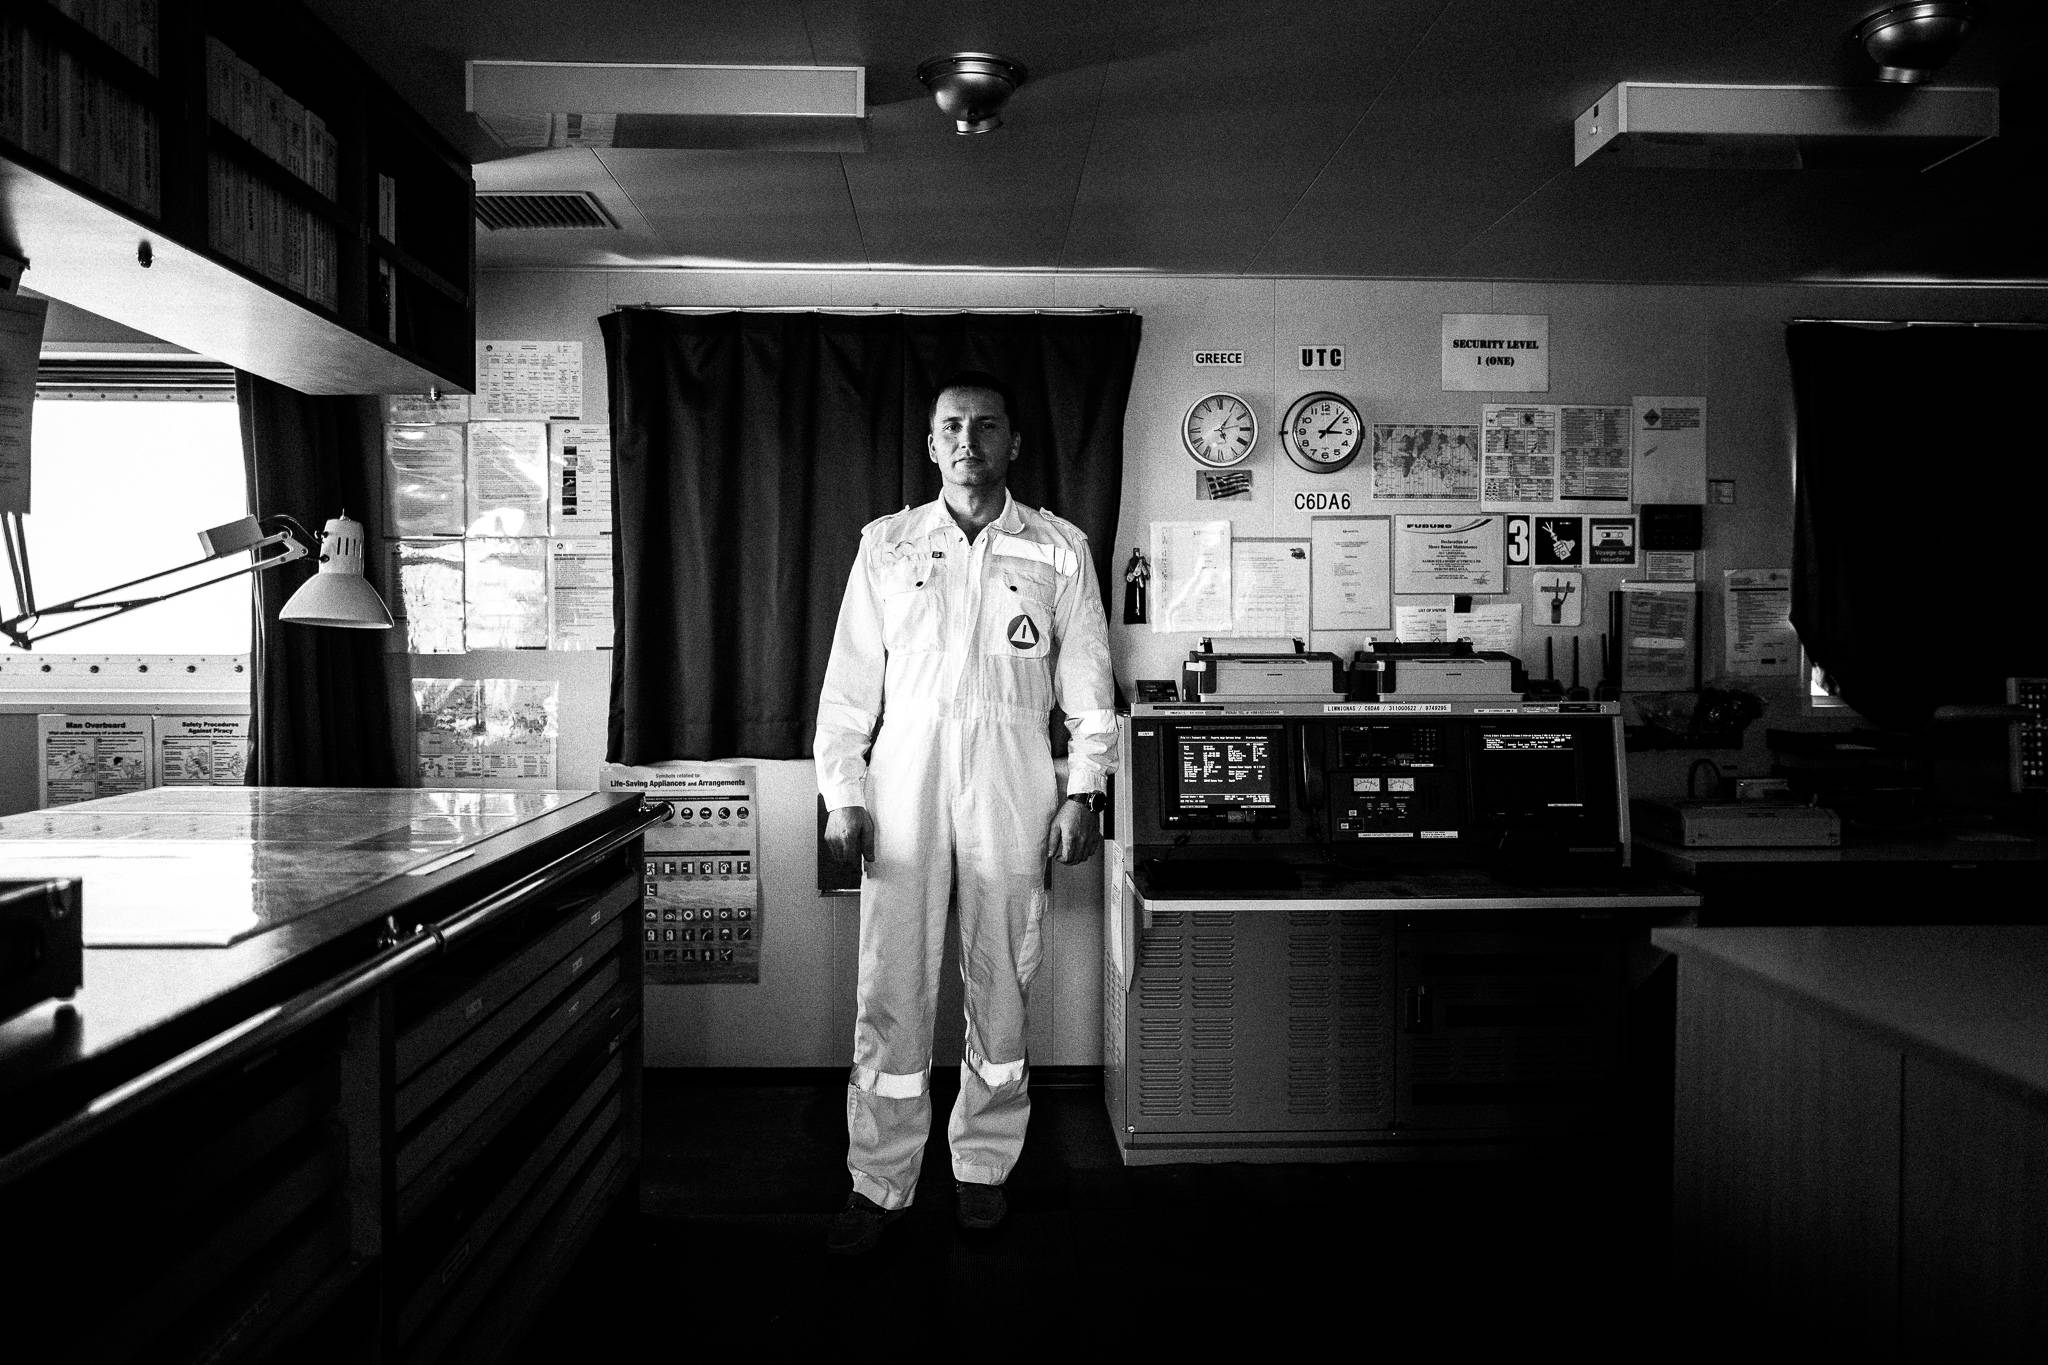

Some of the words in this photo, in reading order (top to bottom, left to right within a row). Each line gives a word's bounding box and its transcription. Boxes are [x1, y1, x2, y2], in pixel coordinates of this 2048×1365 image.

[1453, 340, 1504, 349] SECURITY
[1507, 341, 1539, 349] LEVEL
[1196, 353, 1242, 364] GREECE
[1302, 348, 1341, 367] UTC
[1486, 356, 1514, 367] (ONE)
[1311, 407, 1317, 415] 11
[1295, 494, 1350, 510] C6DA6
[1508, 519, 1528, 562] 3
[1595, 549, 1616, 557] Voyage
[610, 780, 648, 788] Life-Saving
[649, 780, 686, 788] Appliances
[698, 779, 745, 787] Arrangements
